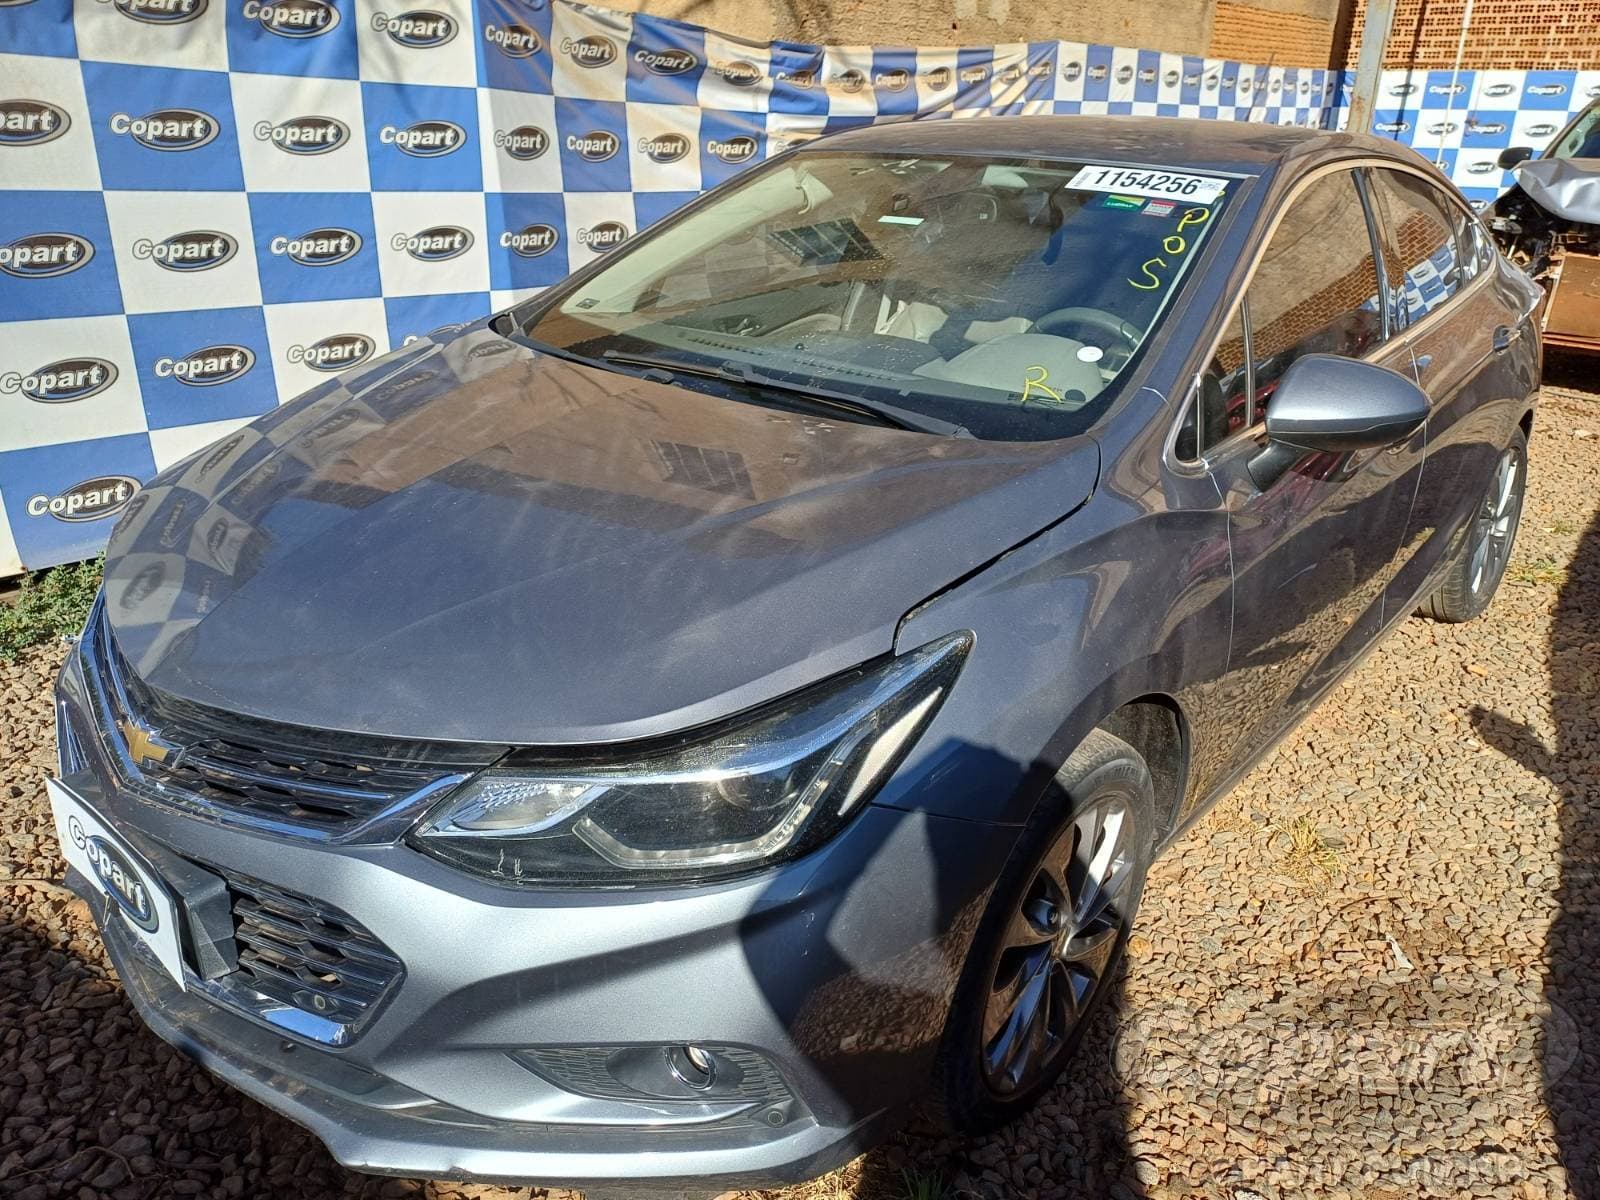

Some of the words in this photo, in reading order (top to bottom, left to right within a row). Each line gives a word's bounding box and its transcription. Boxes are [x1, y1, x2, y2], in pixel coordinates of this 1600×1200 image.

[243, 1, 327, 26] Copart
[371, 12, 448, 36] Copart
[486, 25, 535, 48] Copart
[560, 36, 610, 58] Copart
[634, 50, 691, 69] Copart
[0, 110, 52, 132] art
[110, 113, 205, 139] Copart
[254, 121, 337, 144] Copart
[380, 126, 455, 148] Copart
[494, 129, 542, 151] Copart
[566, 135, 612, 155] Copart
[637, 137, 684, 155] Copart
[707, 140, 751, 156] Copart
[1094, 169, 1203, 195] 1154256
[271, 234, 351, 257] Copart
[391, 230, 463, 253] Copart
[500, 229, 551, 249] Copart
[577, 227, 622, 246] Copart
[0, 241, 77, 268] opart
[132, 237, 225, 262] Copart
[287, 339, 364, 366] Copart
[154, 350, 243, 379] Copart
[0, 365, 102, 396] Copart
[26, 481, 129, 518] Copart
[68, 814, 148, 913] Copart
